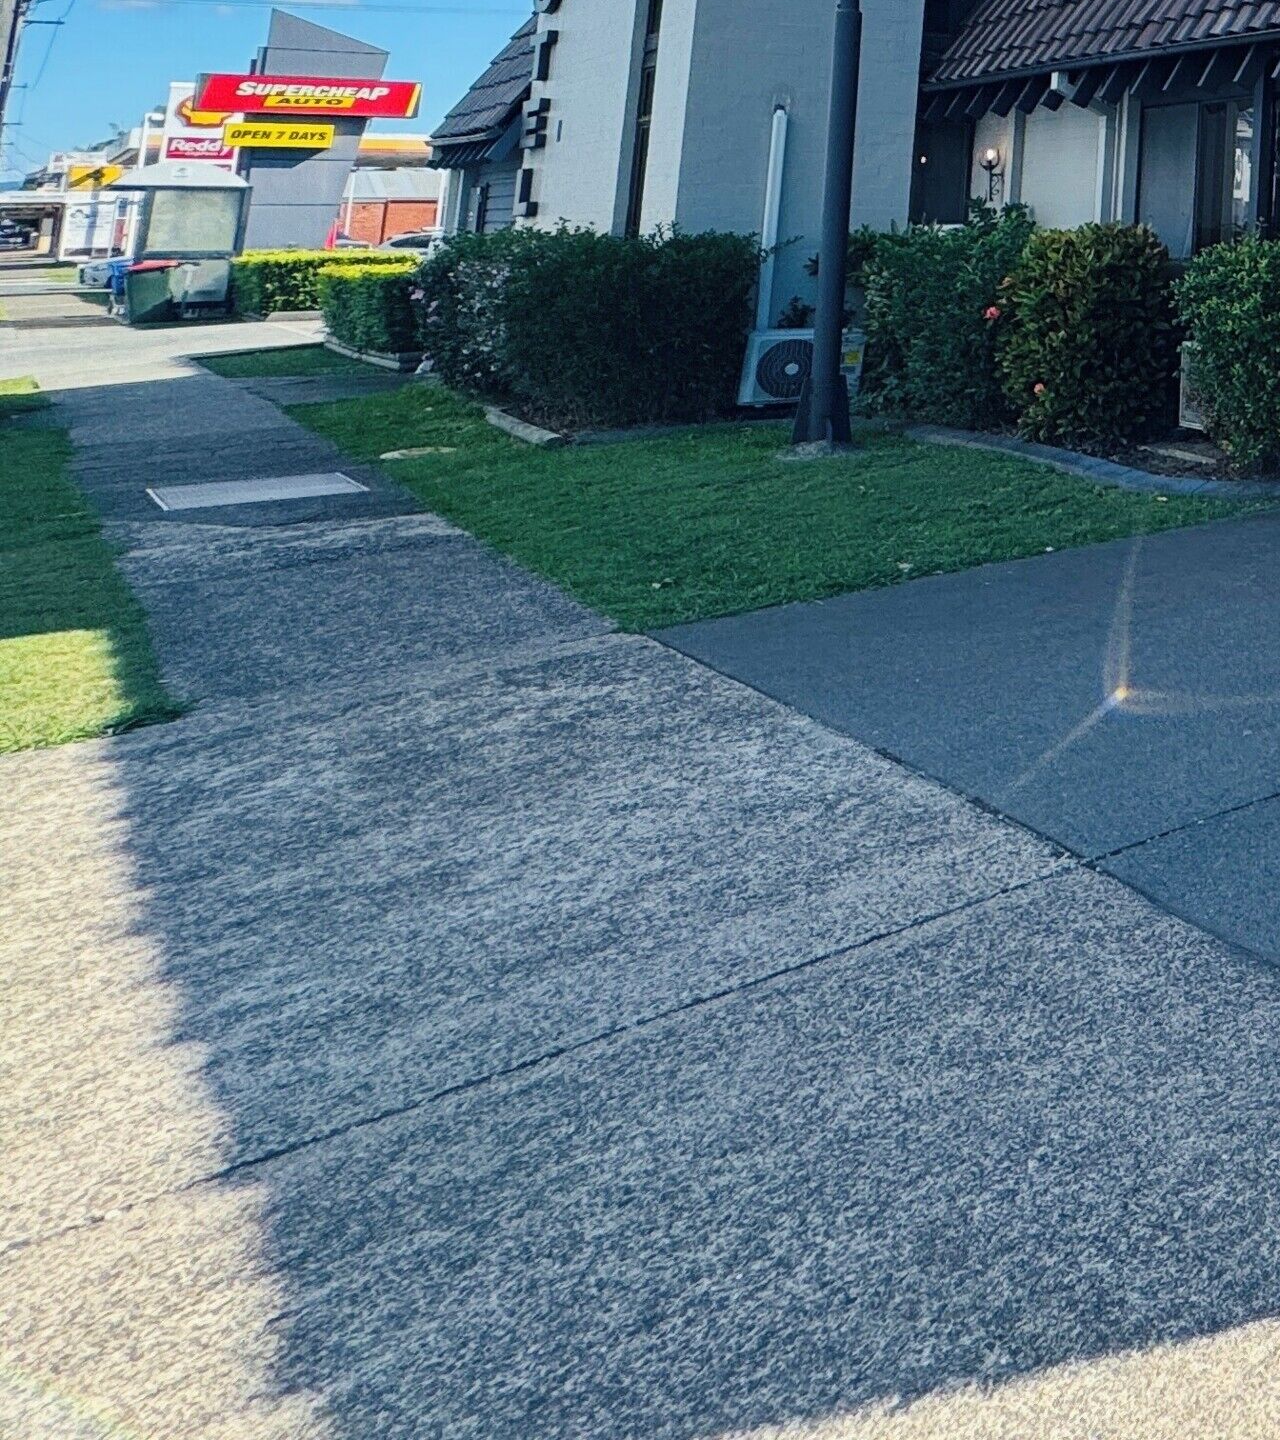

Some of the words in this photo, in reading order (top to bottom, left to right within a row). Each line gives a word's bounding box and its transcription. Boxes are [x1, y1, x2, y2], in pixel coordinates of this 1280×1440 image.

[235, 81, 390, 101] SUPERCHEAP
[275, 98, 343, 106] AUTO
[230, 129, 270, 140] OPEN
[275, 131, 286, 140] 7
[288, 131, 329, 142] DAYS
